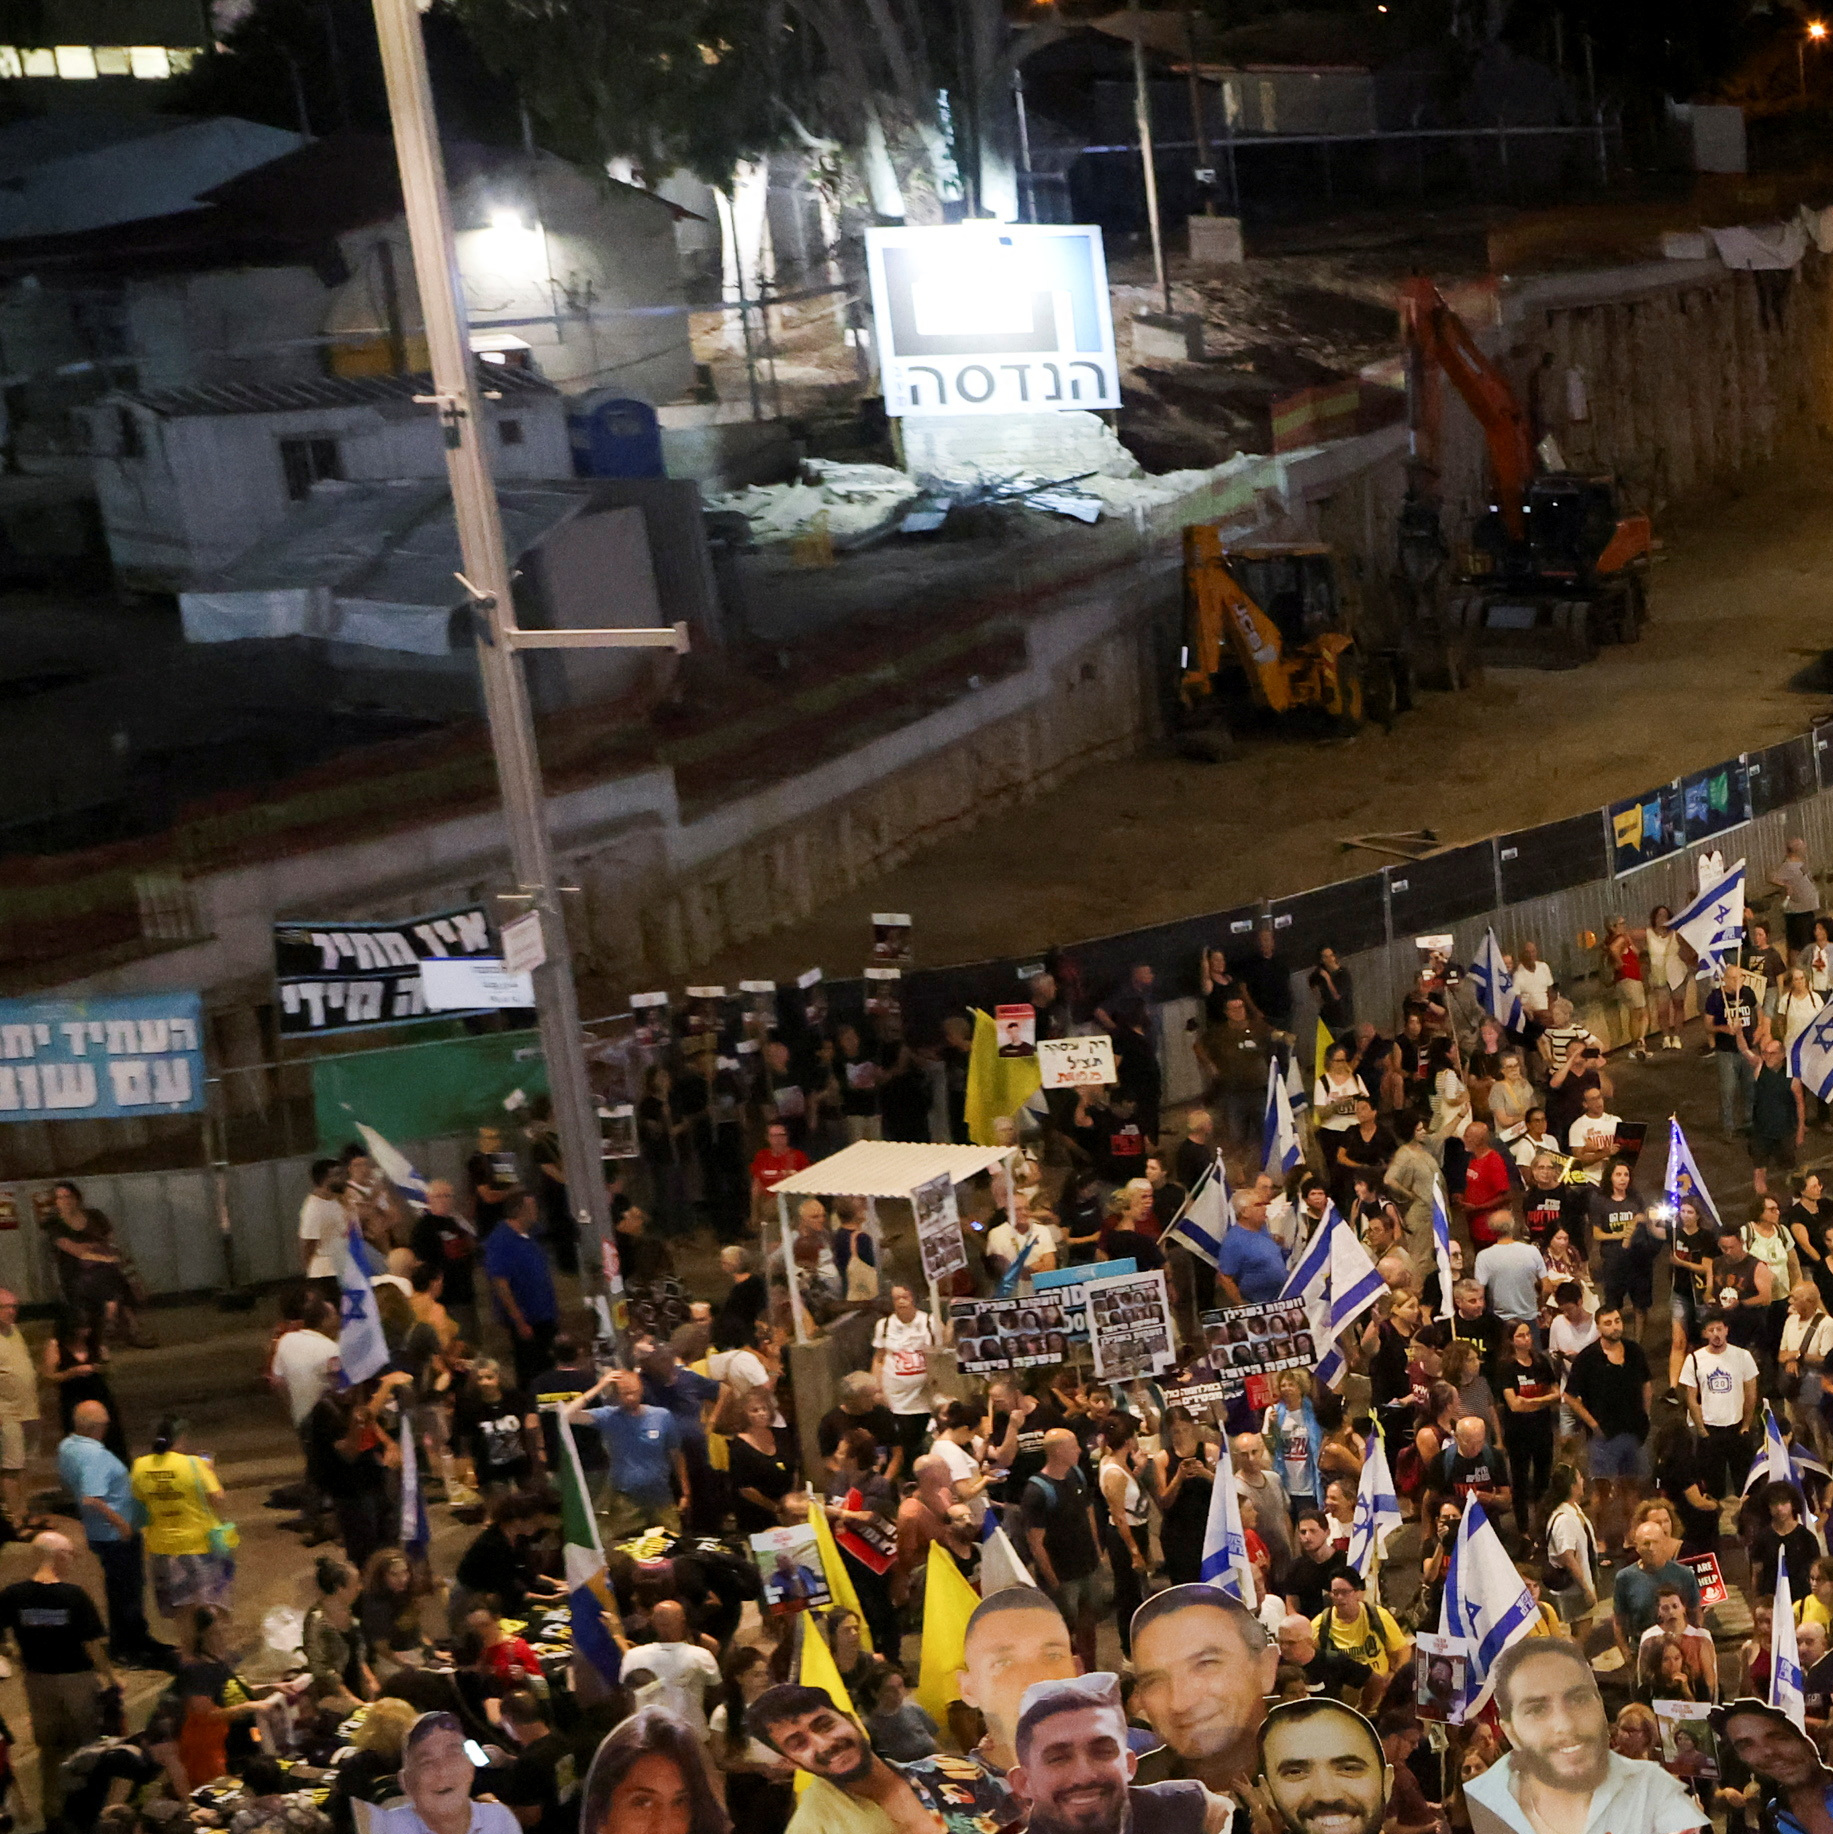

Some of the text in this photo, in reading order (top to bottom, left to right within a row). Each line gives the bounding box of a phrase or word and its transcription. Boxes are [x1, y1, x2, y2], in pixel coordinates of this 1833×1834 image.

[909, 361, 1108, 405] הנדסה
[61, 1018, 199, 1058] העתיד
[110, 1060, 190, 1110] עם
[1697, 1562, 1713, 1574] ARE
[1698, 1575, 1719, 1587] HELP
